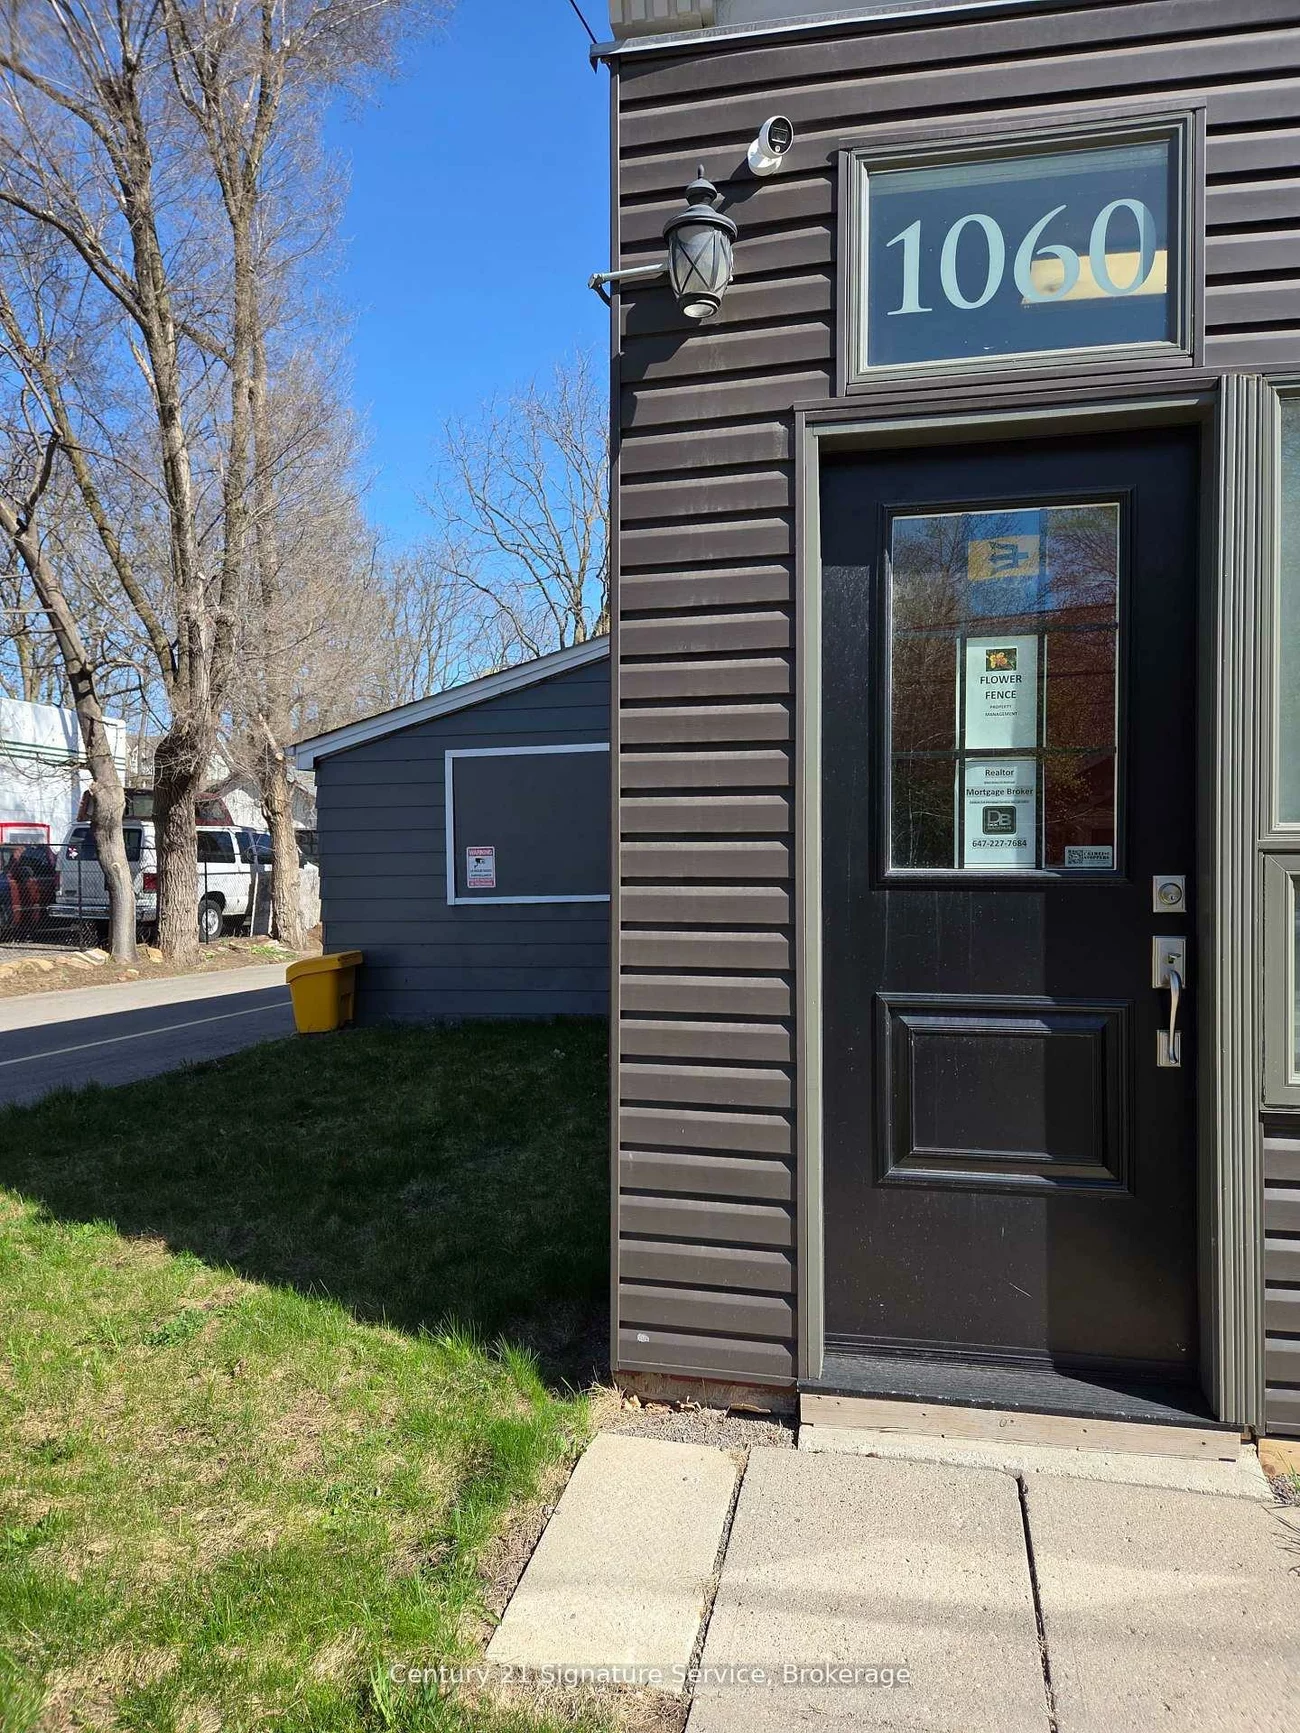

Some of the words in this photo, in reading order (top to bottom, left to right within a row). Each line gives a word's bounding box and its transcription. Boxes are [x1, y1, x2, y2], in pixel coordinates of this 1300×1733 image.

[886, 198, 1156, 316] 1060
[980, 675, 1022, 685] FLOWER
[985, 690, 1017, 700] FENCE
[966, 788, 1005, 797] Mortgage
[1006, 787, 1034, 796] Broker
[972, 839, 1028, 848] 647-227-7684
